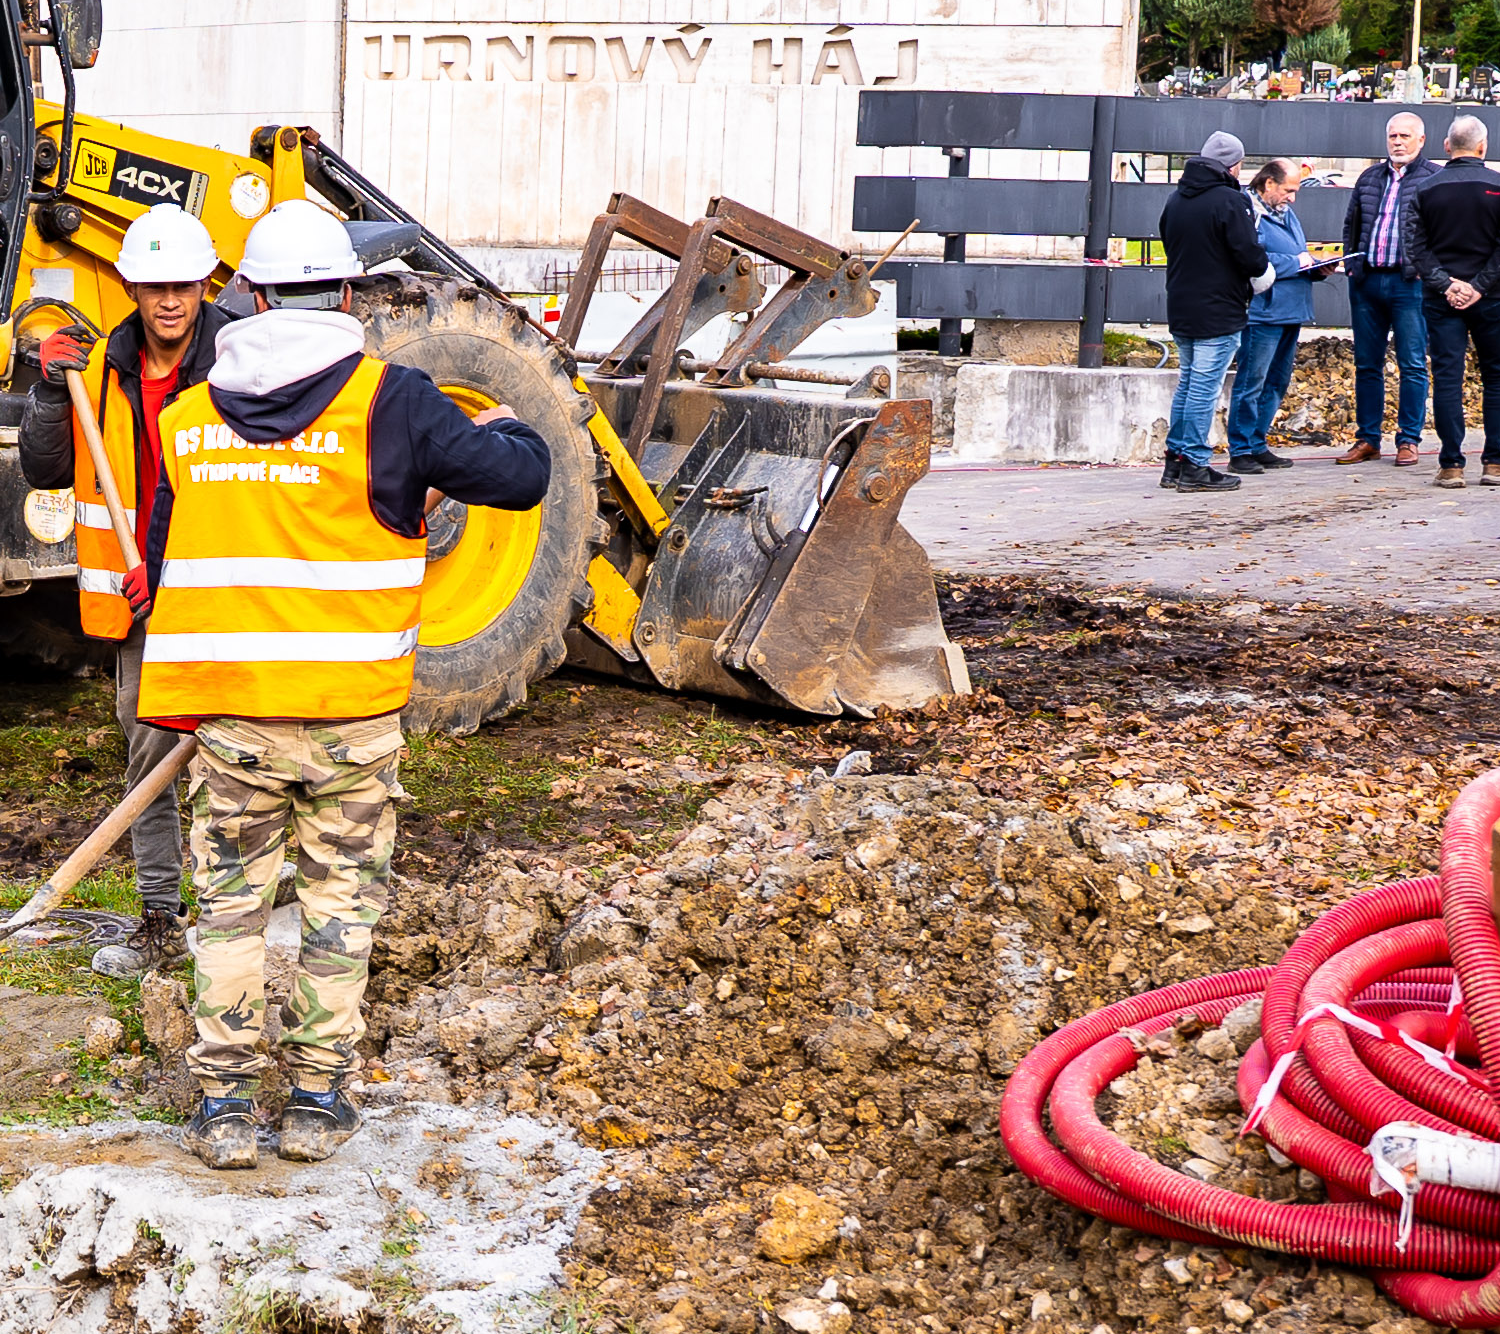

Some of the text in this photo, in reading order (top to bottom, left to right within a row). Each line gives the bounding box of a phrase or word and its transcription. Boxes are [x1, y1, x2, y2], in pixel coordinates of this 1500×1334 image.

[362, 22, 919, 87] URNOVÝ HÁJ
[84, 152, 108, 176] JCB
[116, 166, 184, 201] 4CX
[189, 460, 321, 484] VÝKOPOVÉ PRÁCE
